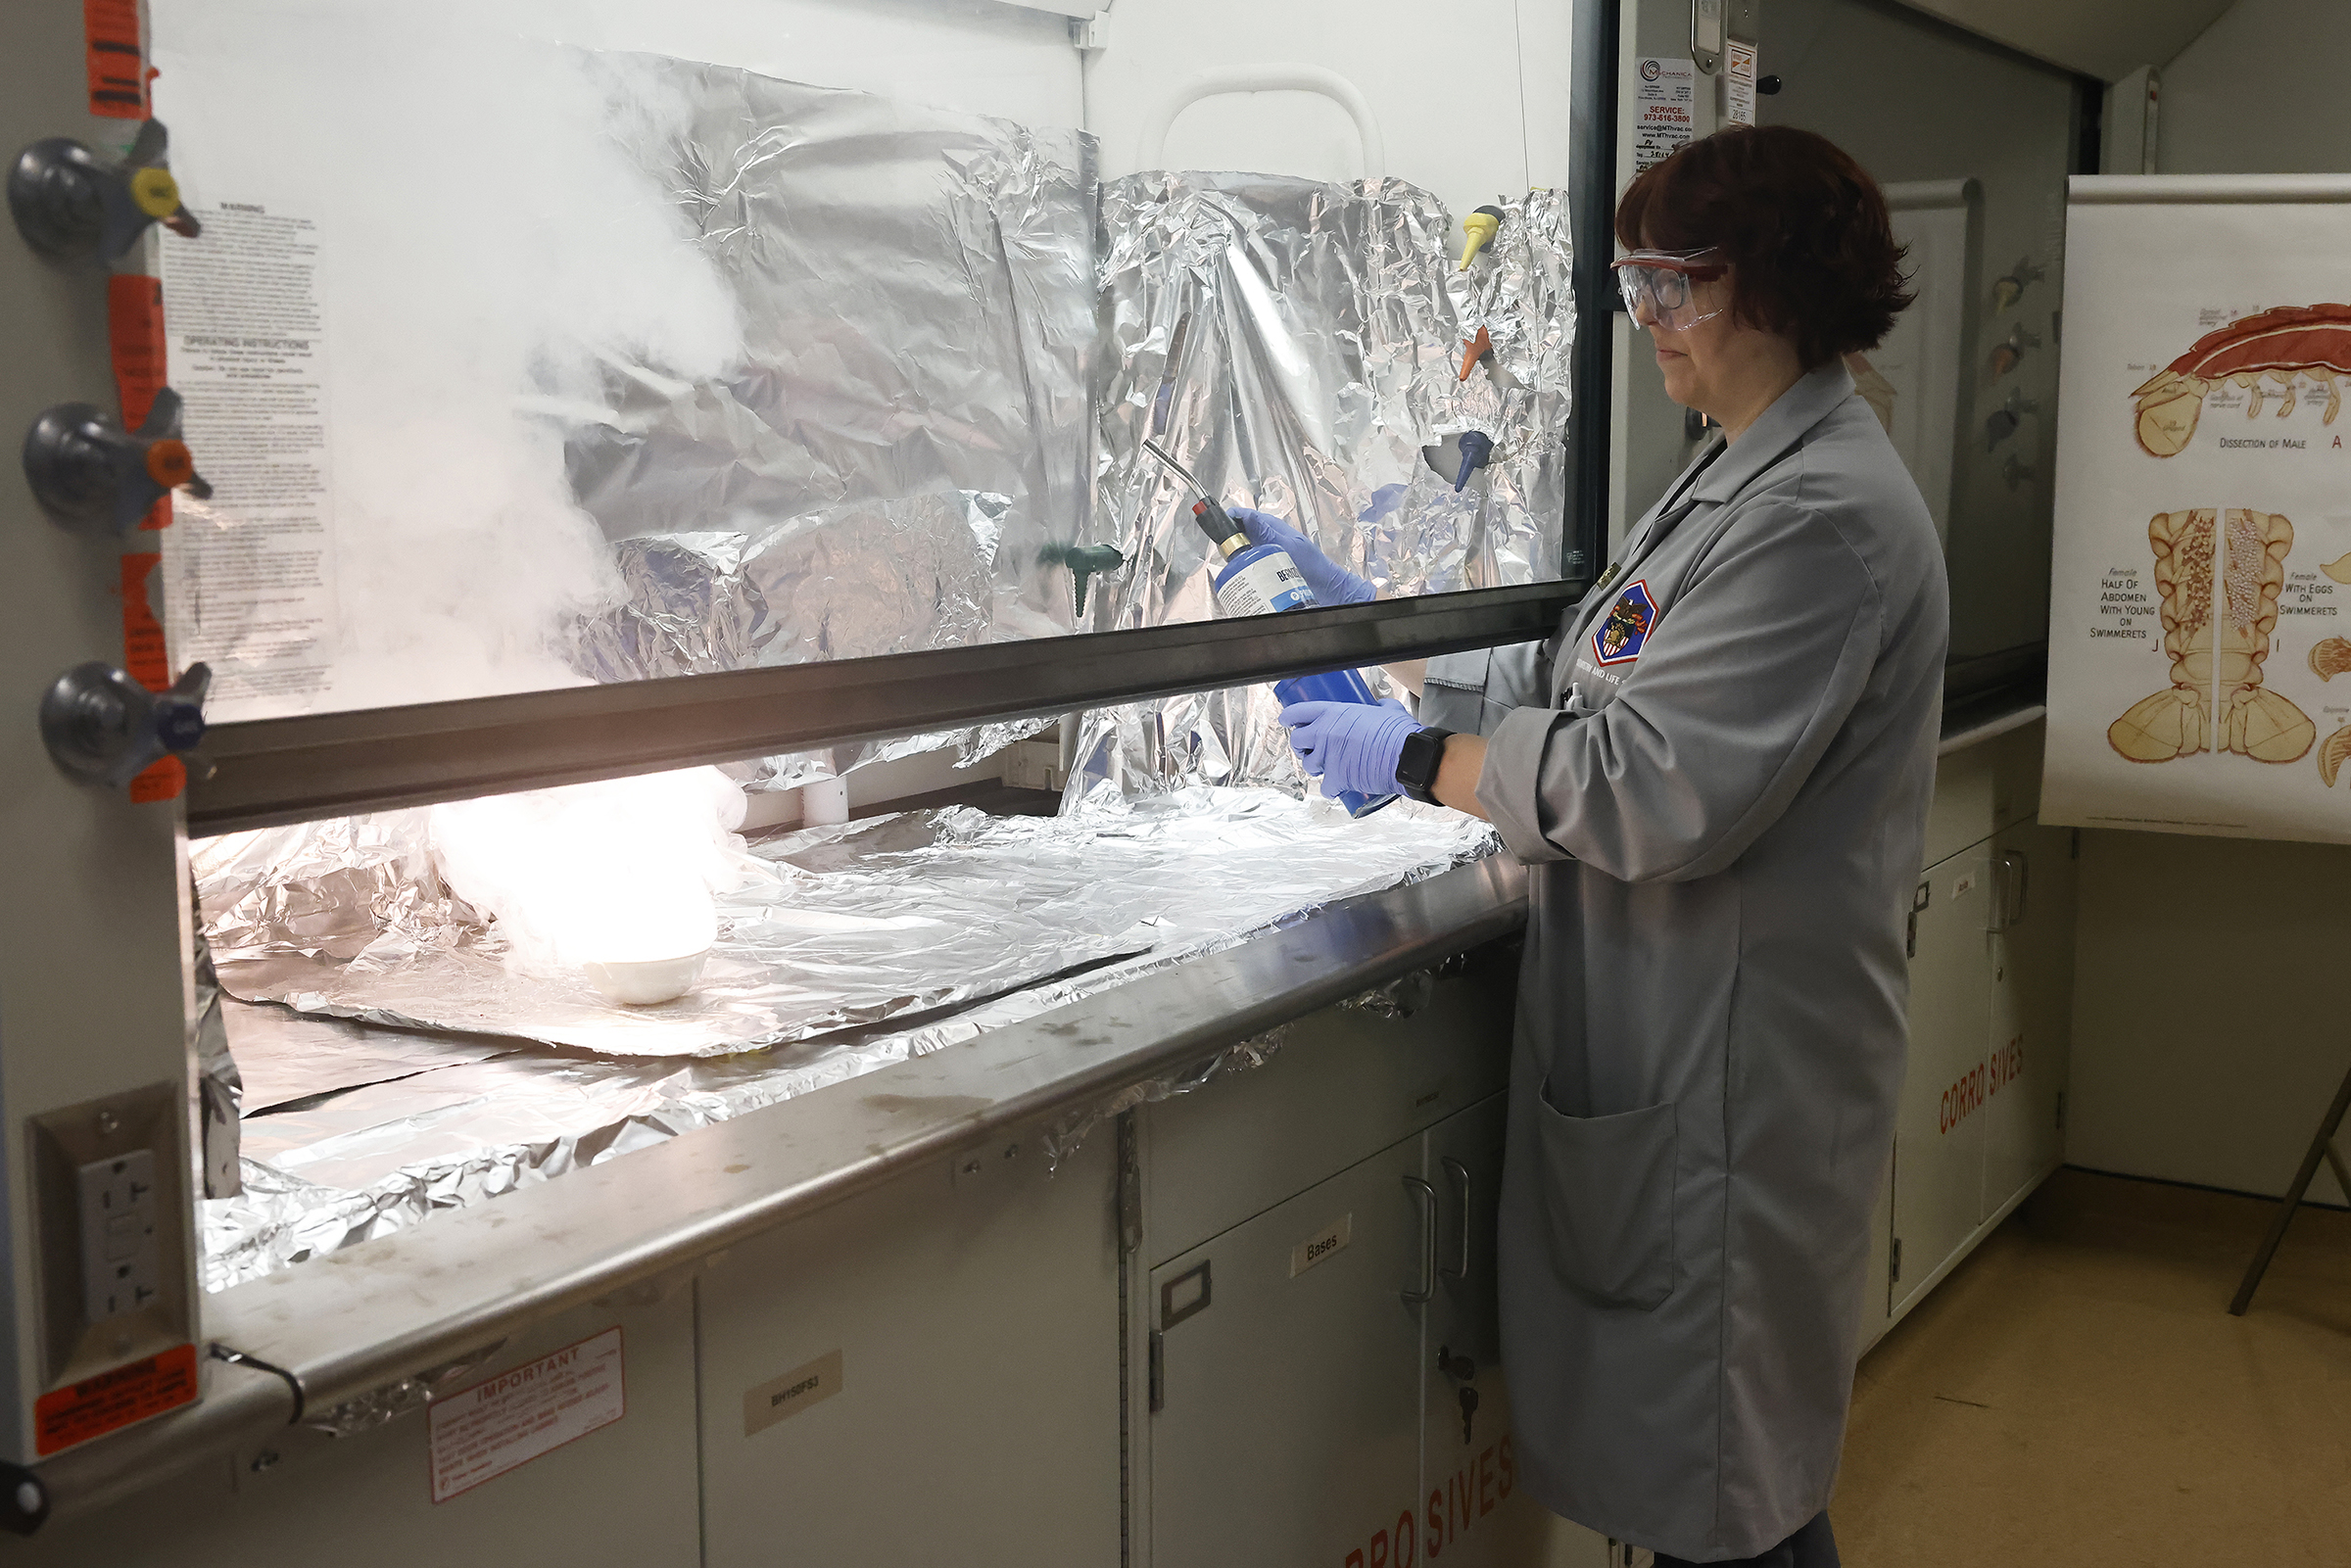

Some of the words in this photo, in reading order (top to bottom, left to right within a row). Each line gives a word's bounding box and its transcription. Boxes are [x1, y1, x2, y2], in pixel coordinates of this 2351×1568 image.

[1650, 106, 1685, 115] SERVICE:
[2220, 437, 2267, 449] DISSECTION
[2282, 438, 2307, 450] MALE
[2331, 435, 2342, 450] A
[2108, 567, 2137, 577] Female
[2290, 572, 2318, 581] Female
[2101, 579, 2124, 590] HALF
[2285, 584, 2307, 594] WITH
[2309, 585, 2333, 594] EGGS
[2101, 592, 2146, 602] ABDOMEN
[2299, 594, 2313, 603] ON
[2100, 604, 2123, 615] WITH
[2125, 605, 2155, 615] YOUNG
[2279, 605, 2337, 616] SWIMMERETS
[2120, 618, 2132, 627] ON
[2089, 628, 2146, 639] SWIMMERETS
[1592, 666, 1606, 679] AND
[1606, 671, 1620, 686] LIFE
[1307, 1234, 1337, 1261] Bases
[476, 1347, 580, 1402] IMPORTANT
